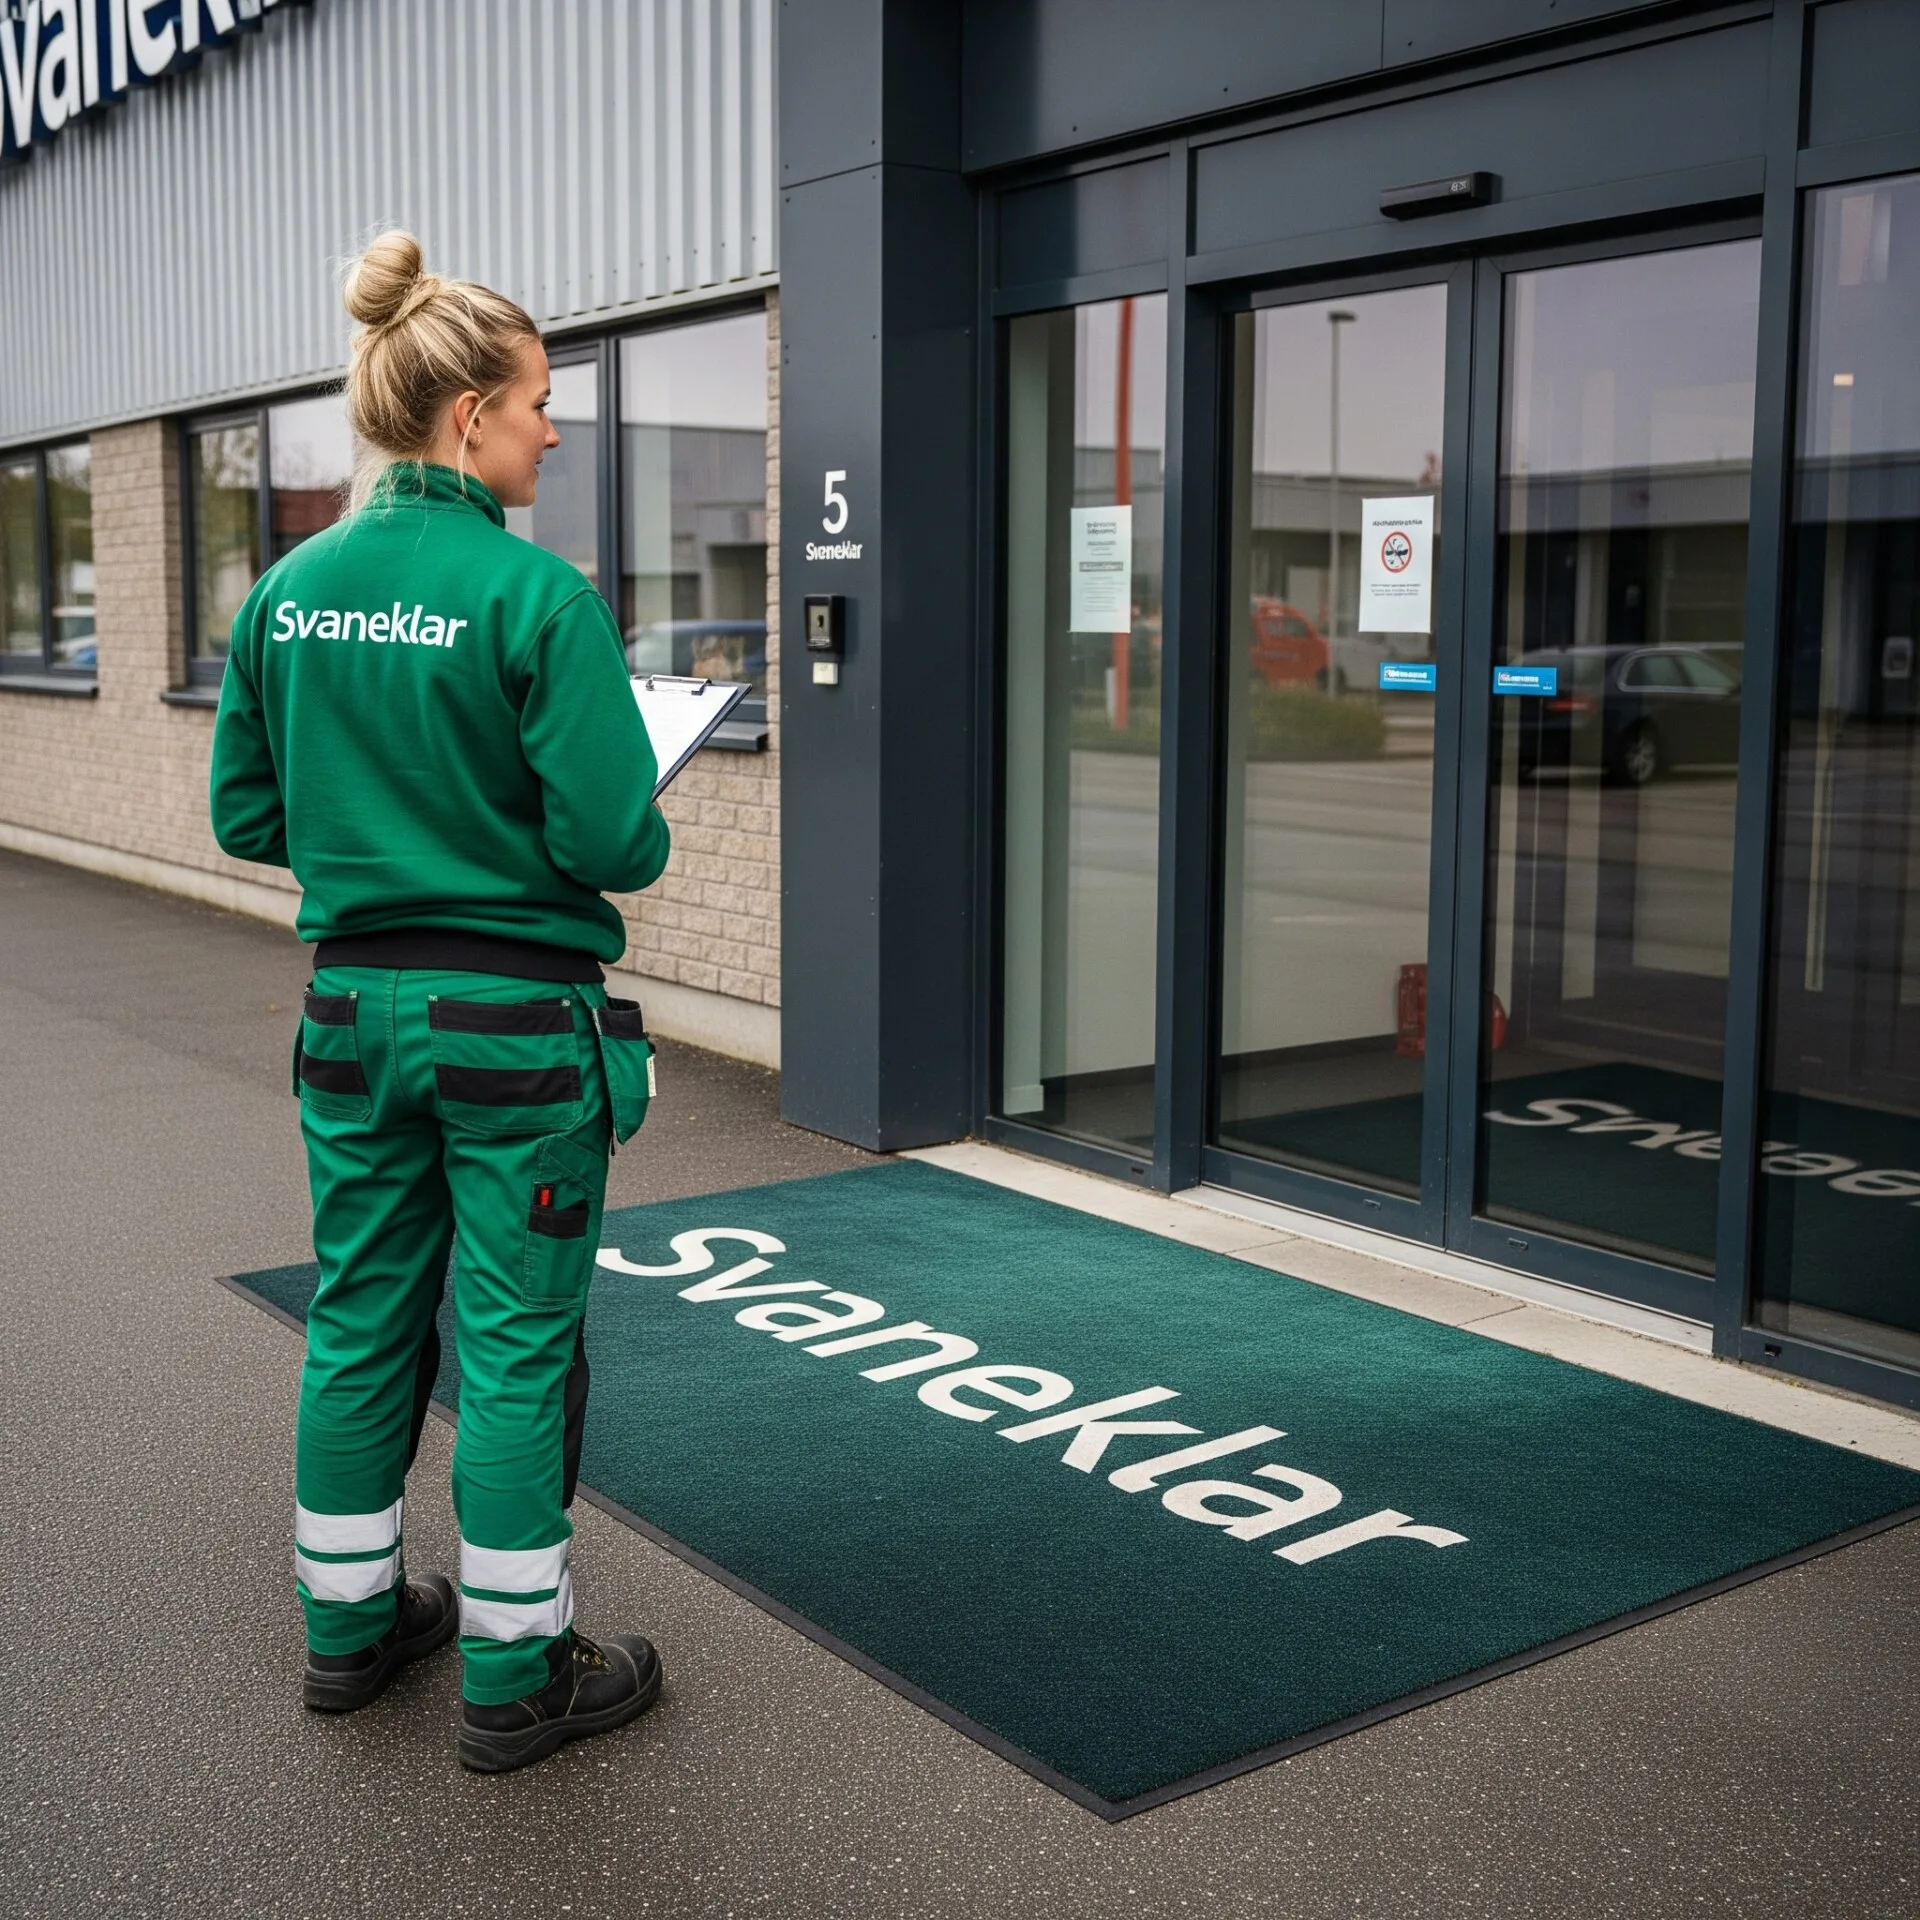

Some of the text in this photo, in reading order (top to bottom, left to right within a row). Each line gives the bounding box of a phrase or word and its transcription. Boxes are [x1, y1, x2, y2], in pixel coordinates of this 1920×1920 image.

[822, 470, 848, 534] 5
[272, 600, 468, 648] Svaneklar
[596, 1227, 1469, 1566] Svaneklar
